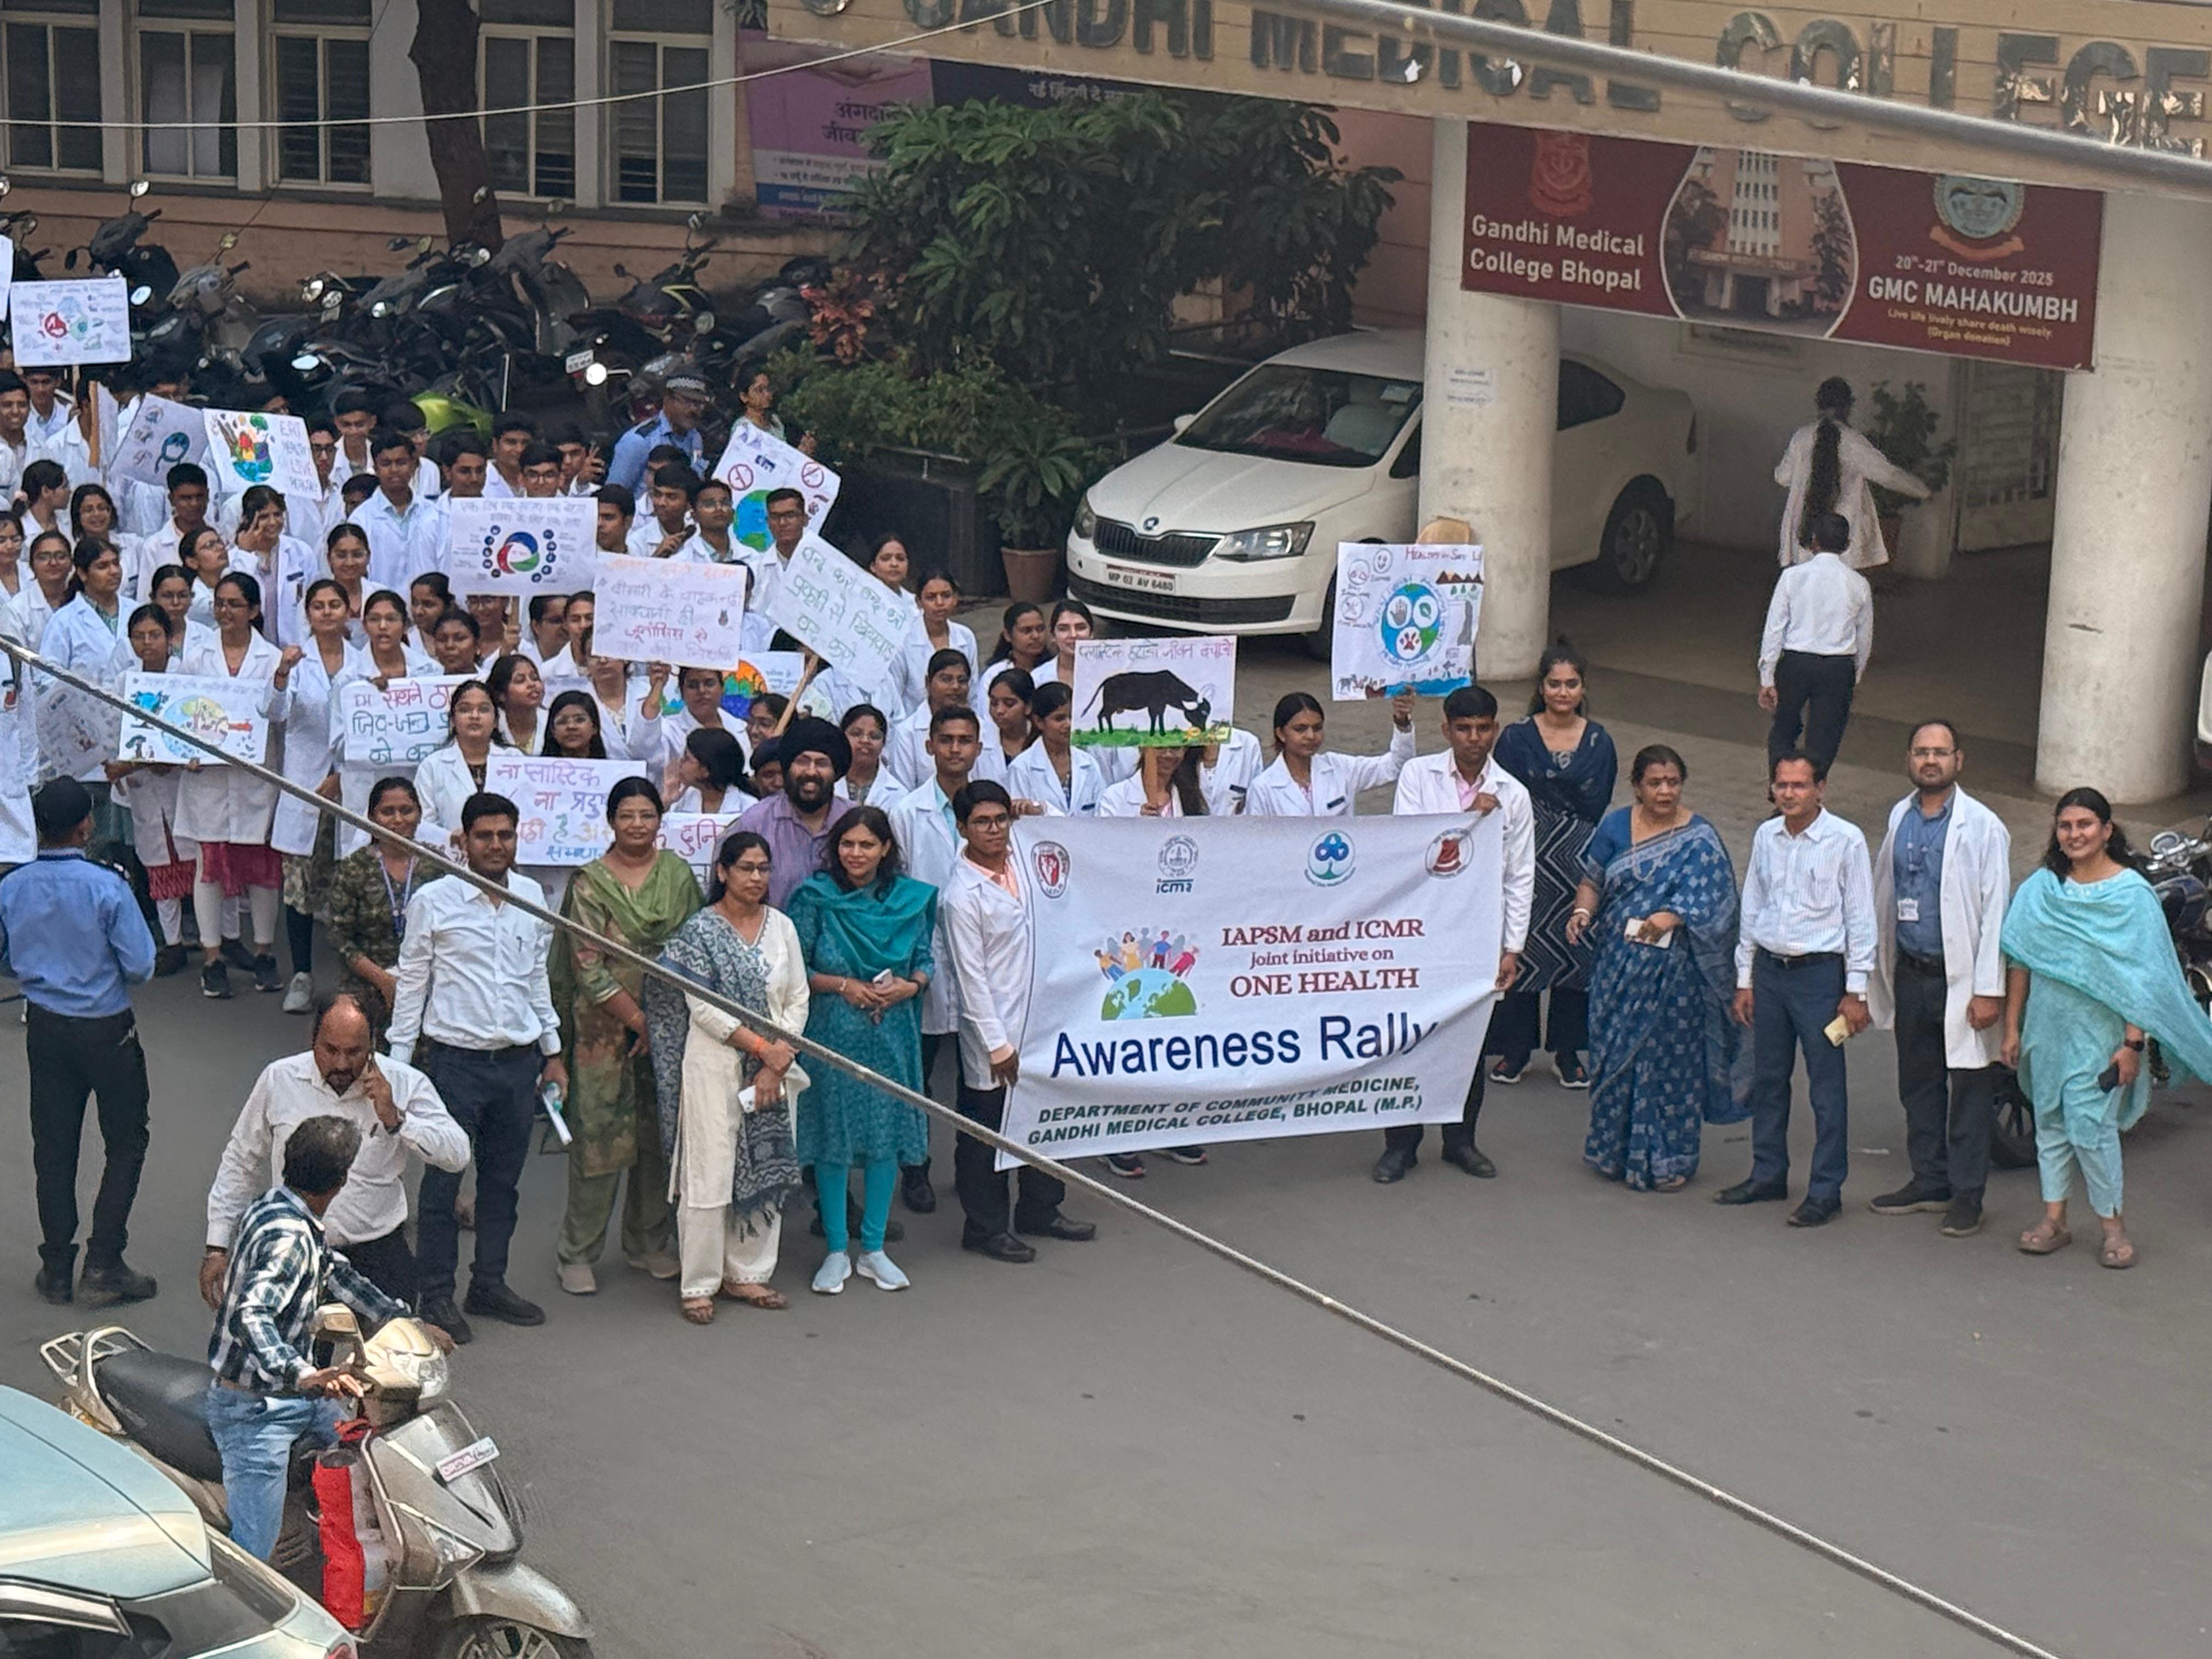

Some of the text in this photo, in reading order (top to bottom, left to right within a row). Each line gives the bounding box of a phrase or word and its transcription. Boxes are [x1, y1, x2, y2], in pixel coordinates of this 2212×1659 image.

[1472, 215, 1645, 257] Gandhi Medical
[1469, 248, 1642, 291] College Bhopal
[1948, 262, 2016, 283] December
[2019, 270, 2055, 287] 2025
[1868, 275, 2079, 323] GMC MAHAKUMBH
[1956, 317, 1985, 330] share
[1988, 320, 2016, 334] death
[533, 791, 562, 811] ना
[1221, 918, 1426, 947] IAPSM and ICMR
[1371, 947, 1395, 961] on
[1230, 967, 1421, 998] ONE HEALTH
[1050, 1011, 1441, 1079] Awareness Rally
[1038, 1075, 1421, 1124] DEPARTMENT OF COMMUNITY MEDICINE,
[1026, 1122, 1101, 1146] GANDHI
[1105, 1115, 1190, 1137] MEDICAL
[1196, 1106, 1286, 1128] COLLEGE,
[1293, 1097, 1368, 1119] BHOPAL
